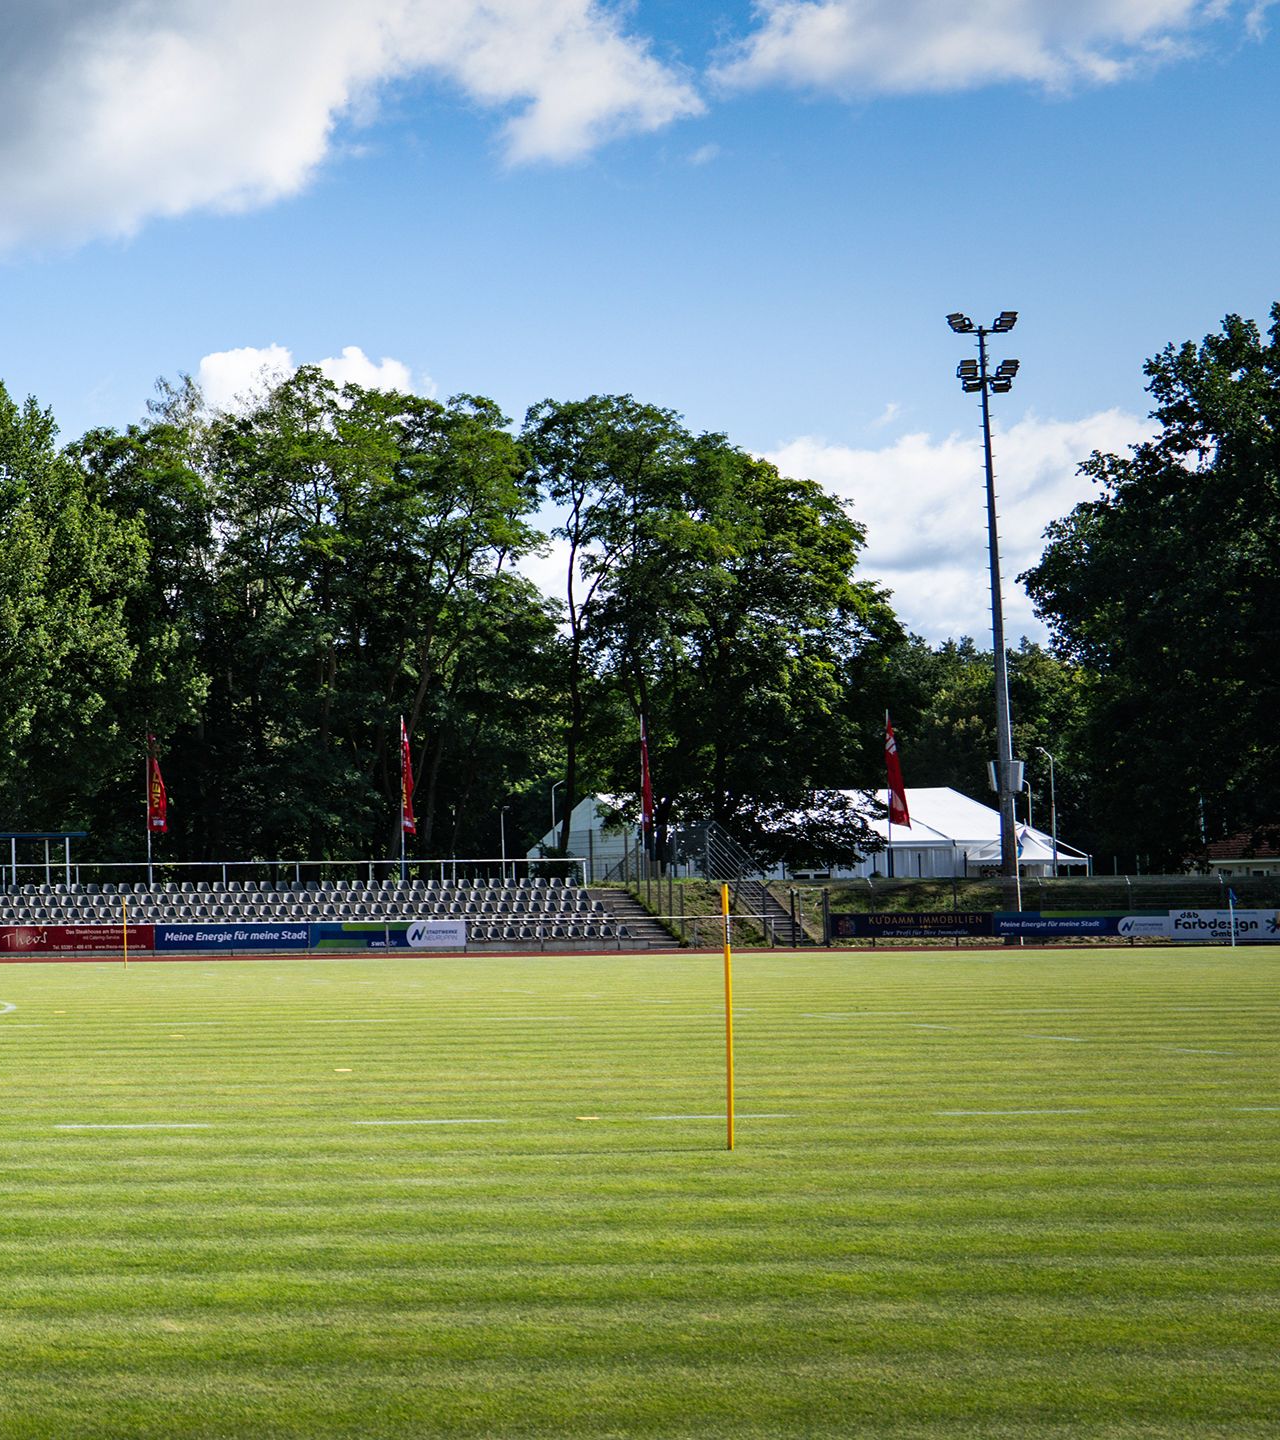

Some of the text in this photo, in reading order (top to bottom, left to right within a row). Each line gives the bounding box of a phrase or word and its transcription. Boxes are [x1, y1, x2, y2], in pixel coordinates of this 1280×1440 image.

[868, 915, 983, 924] KU'DAMM IMMOBILIEN
[1179, 911, 1199, 919] d&b
[1021, 920, 1046, 929] Energie
[1080, 919, 1100, 927] Stadt
[1174, 918, 1259, 932] Farbdesign
[164, 930, 308, 943] Meine Energie für meine Stadt
